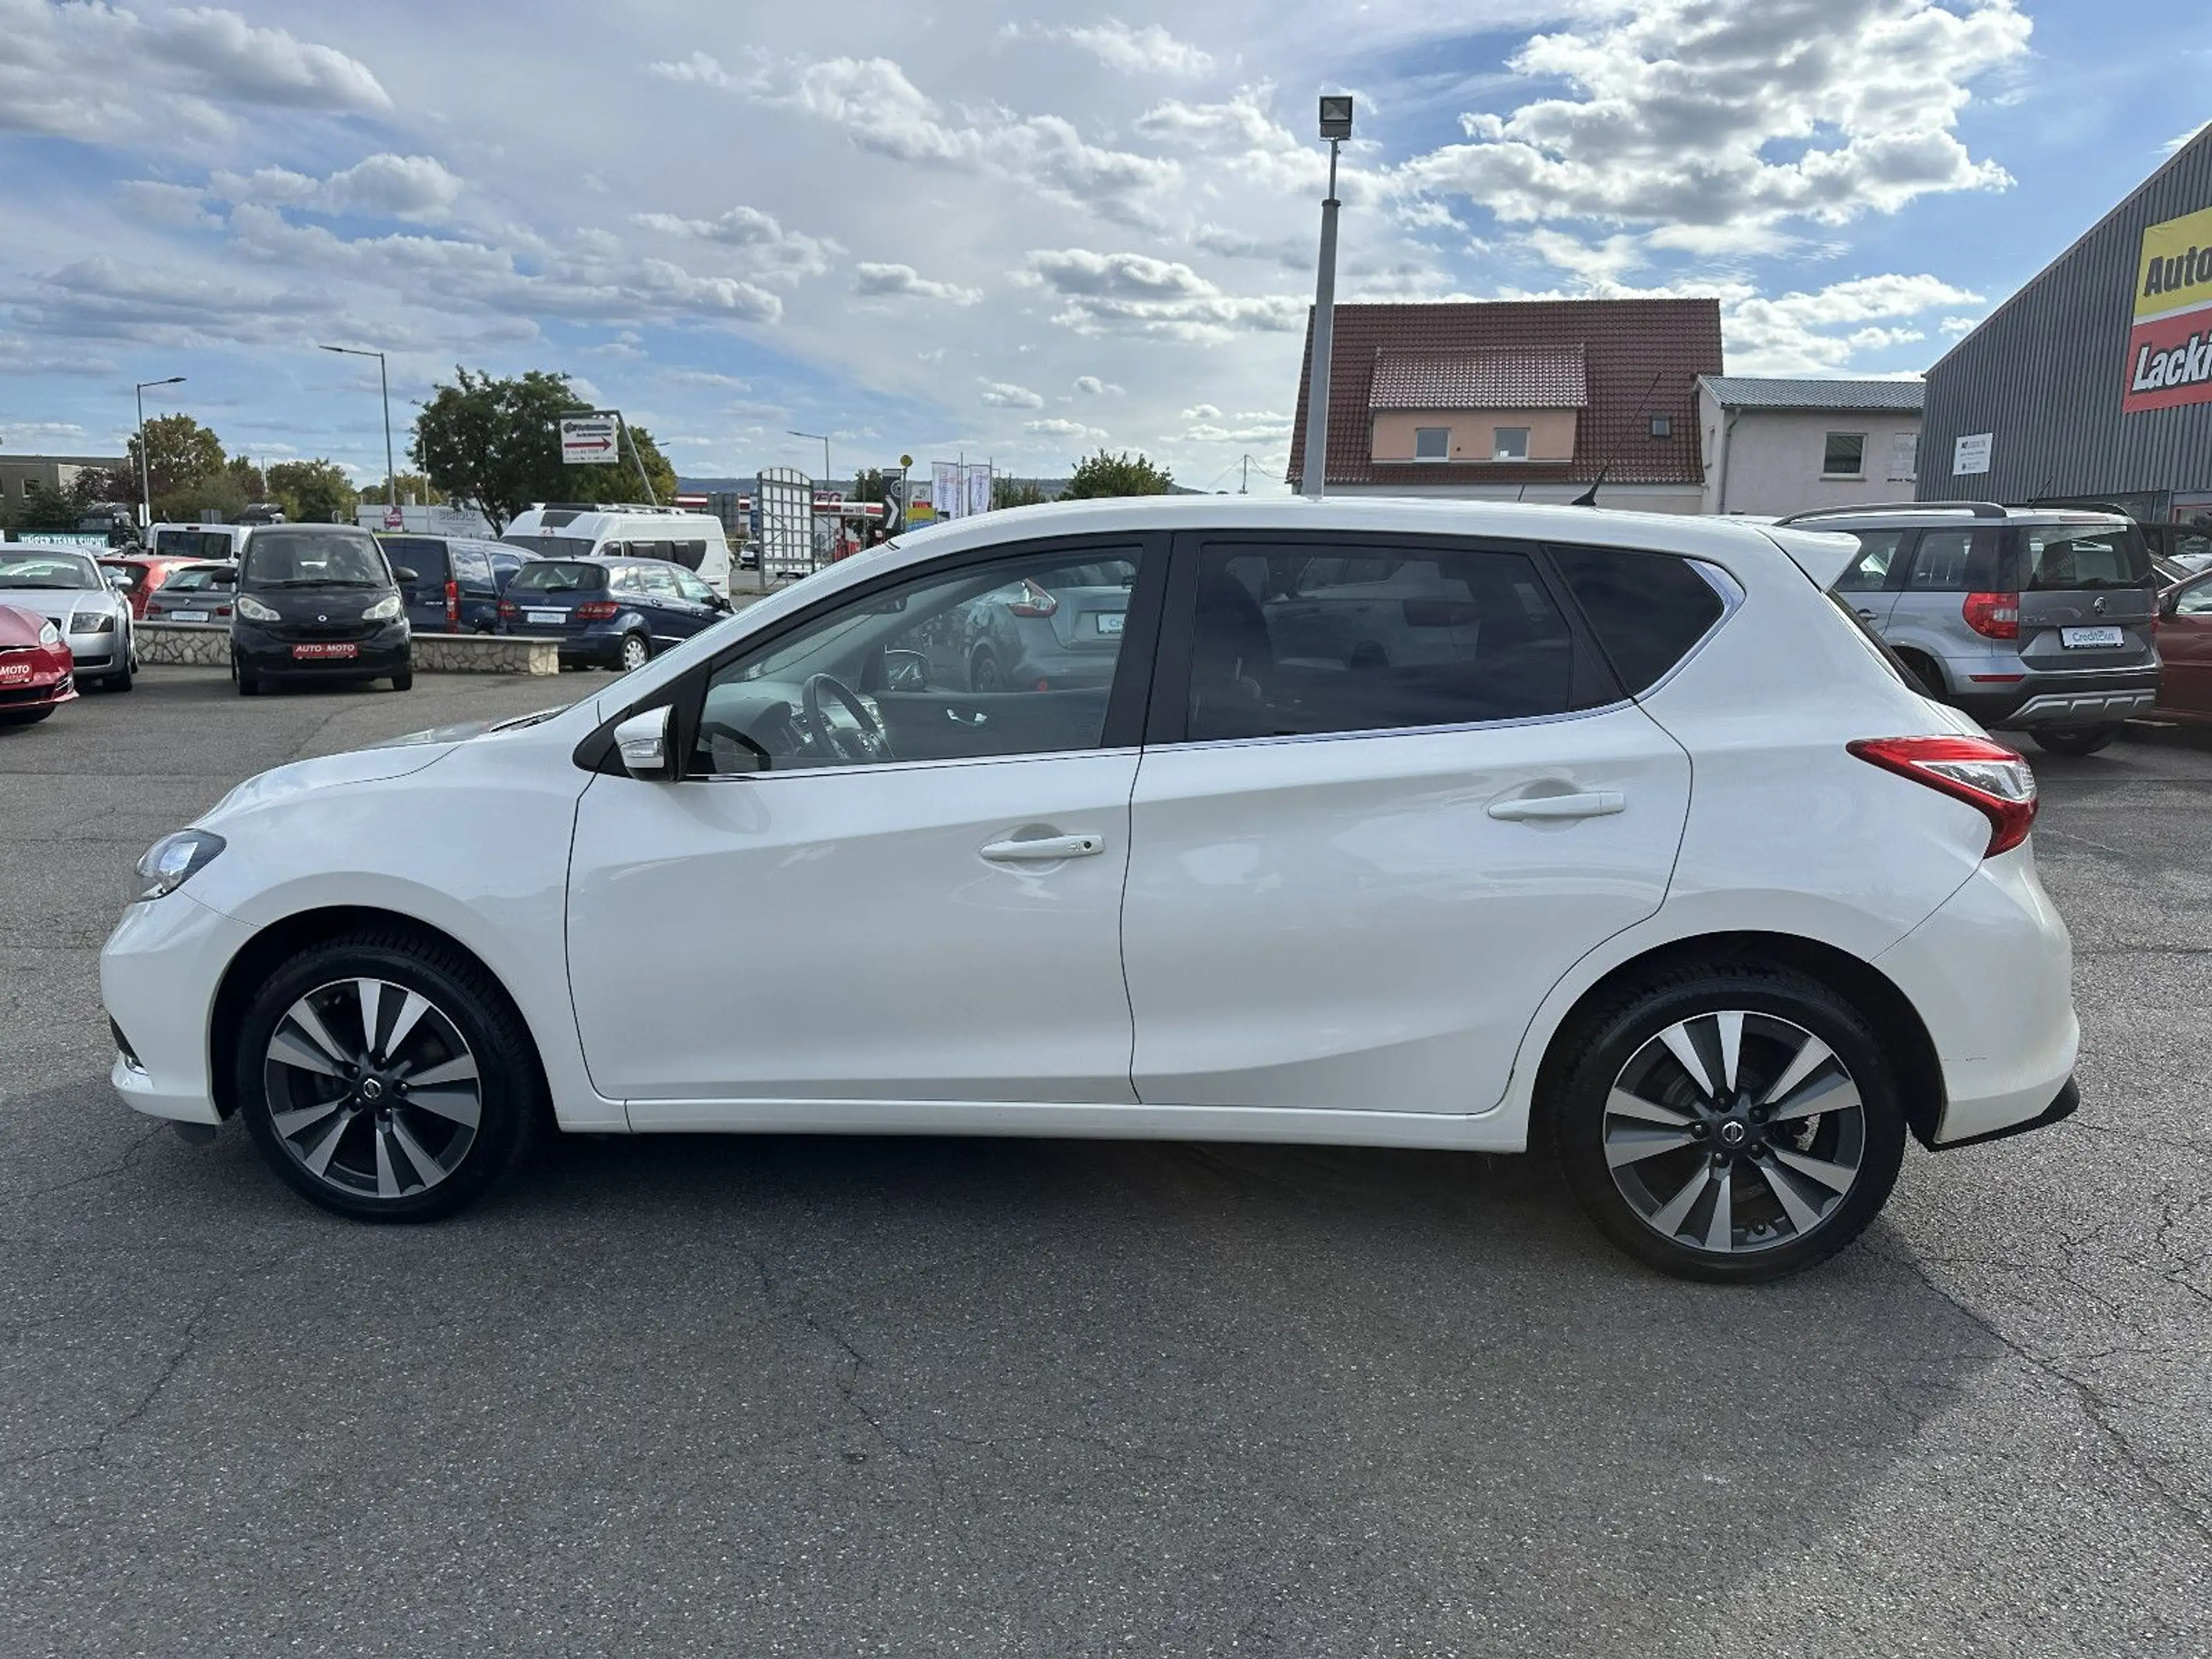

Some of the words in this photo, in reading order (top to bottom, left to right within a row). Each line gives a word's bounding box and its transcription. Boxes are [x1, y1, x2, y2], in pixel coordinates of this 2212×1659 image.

[2143, 246, 2212, 297] Auto
[2131, 332, 2212, 392] Lacki
[327, 644, 355, 652] MOTO
[0, 665, 30, 675] MOTO
